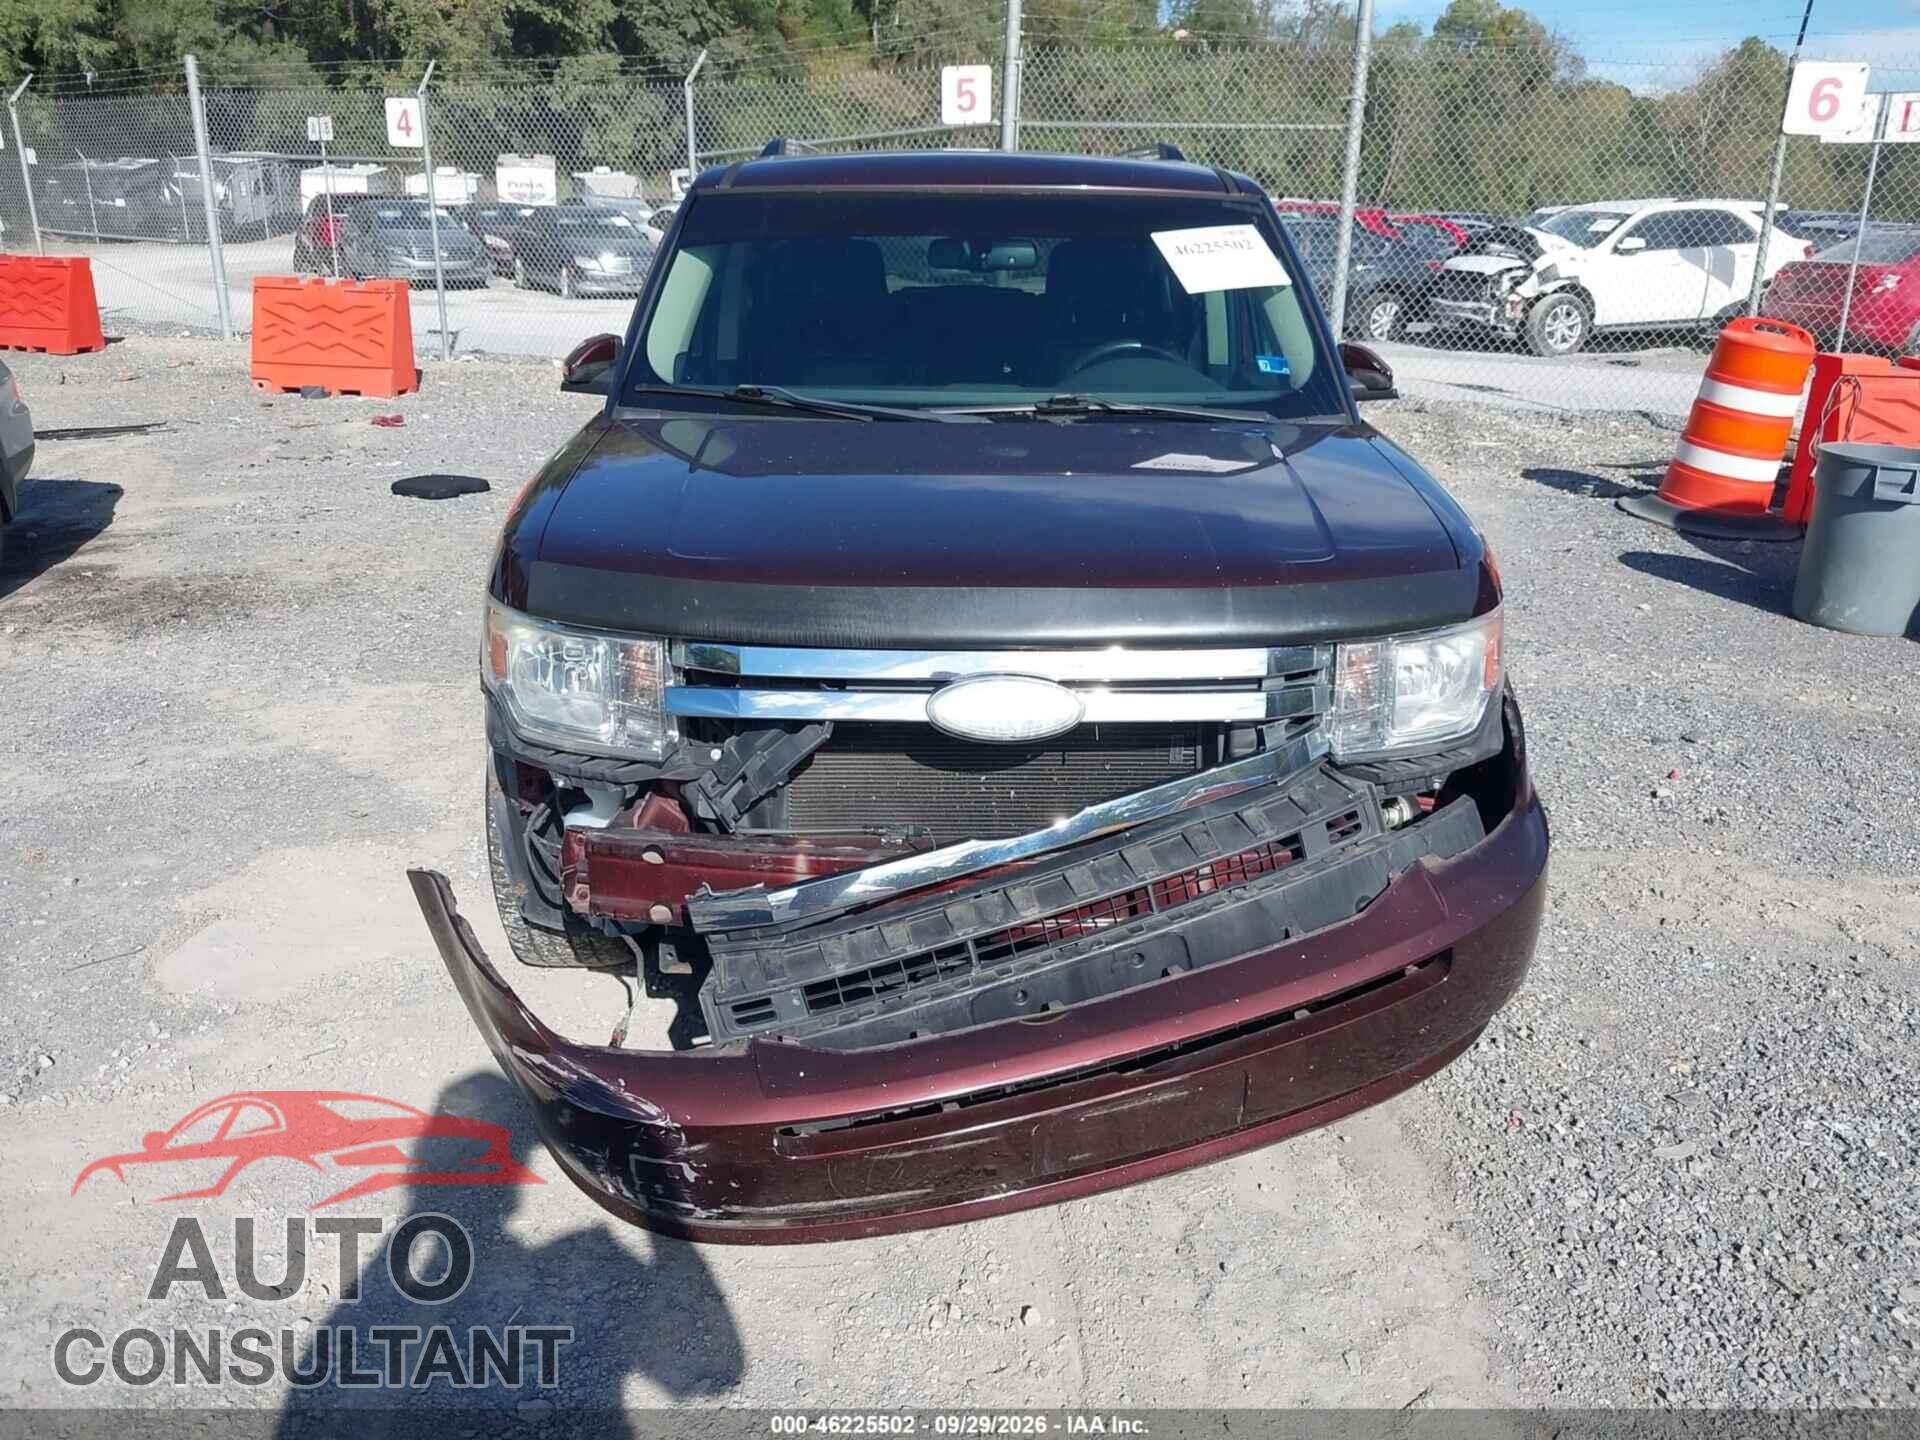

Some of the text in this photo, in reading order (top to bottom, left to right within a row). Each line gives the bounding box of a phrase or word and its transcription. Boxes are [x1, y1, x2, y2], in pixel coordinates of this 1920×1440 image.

[956, 78, 977, 112] 5
[1807, 77, 1843, 122] 6
[397, 108, 413, 137] 4
[1174, 239, 1255, 256] 46225502
